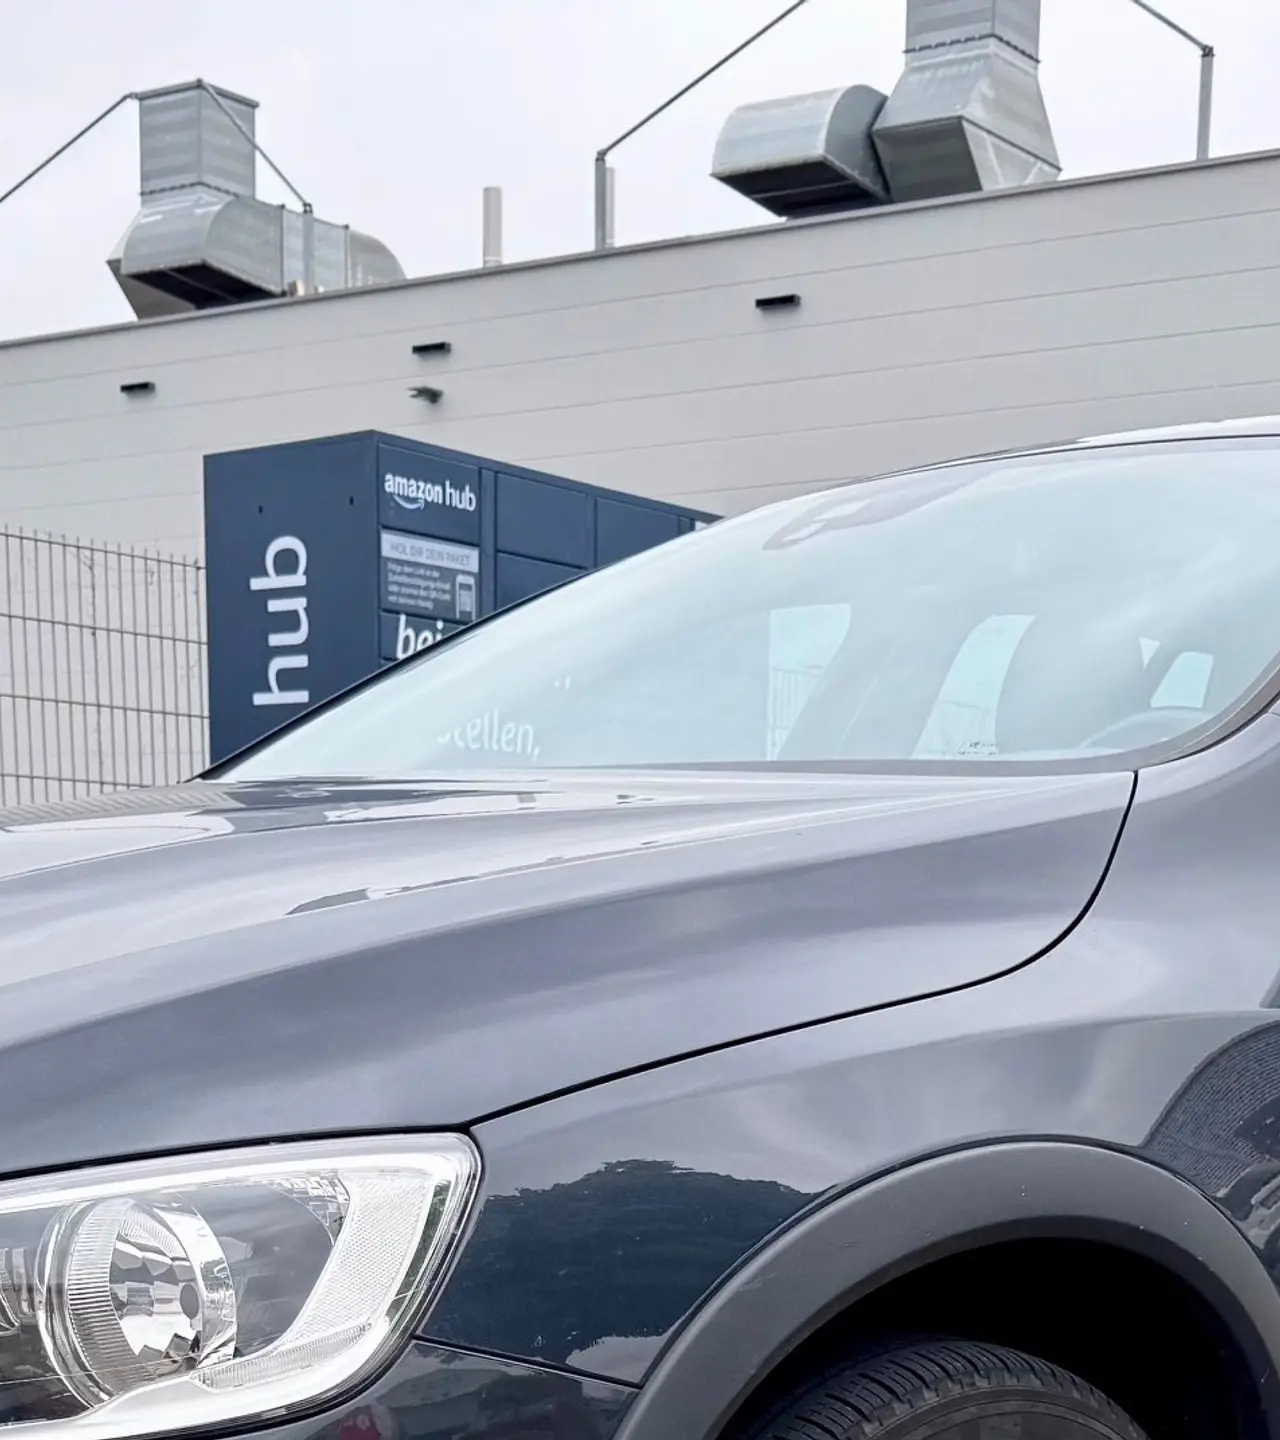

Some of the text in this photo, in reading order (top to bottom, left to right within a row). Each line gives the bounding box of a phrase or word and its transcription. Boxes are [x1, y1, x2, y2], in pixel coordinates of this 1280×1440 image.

[384, 473, 477, 511] amazon hub
[249, 535, 310, 706] hub
